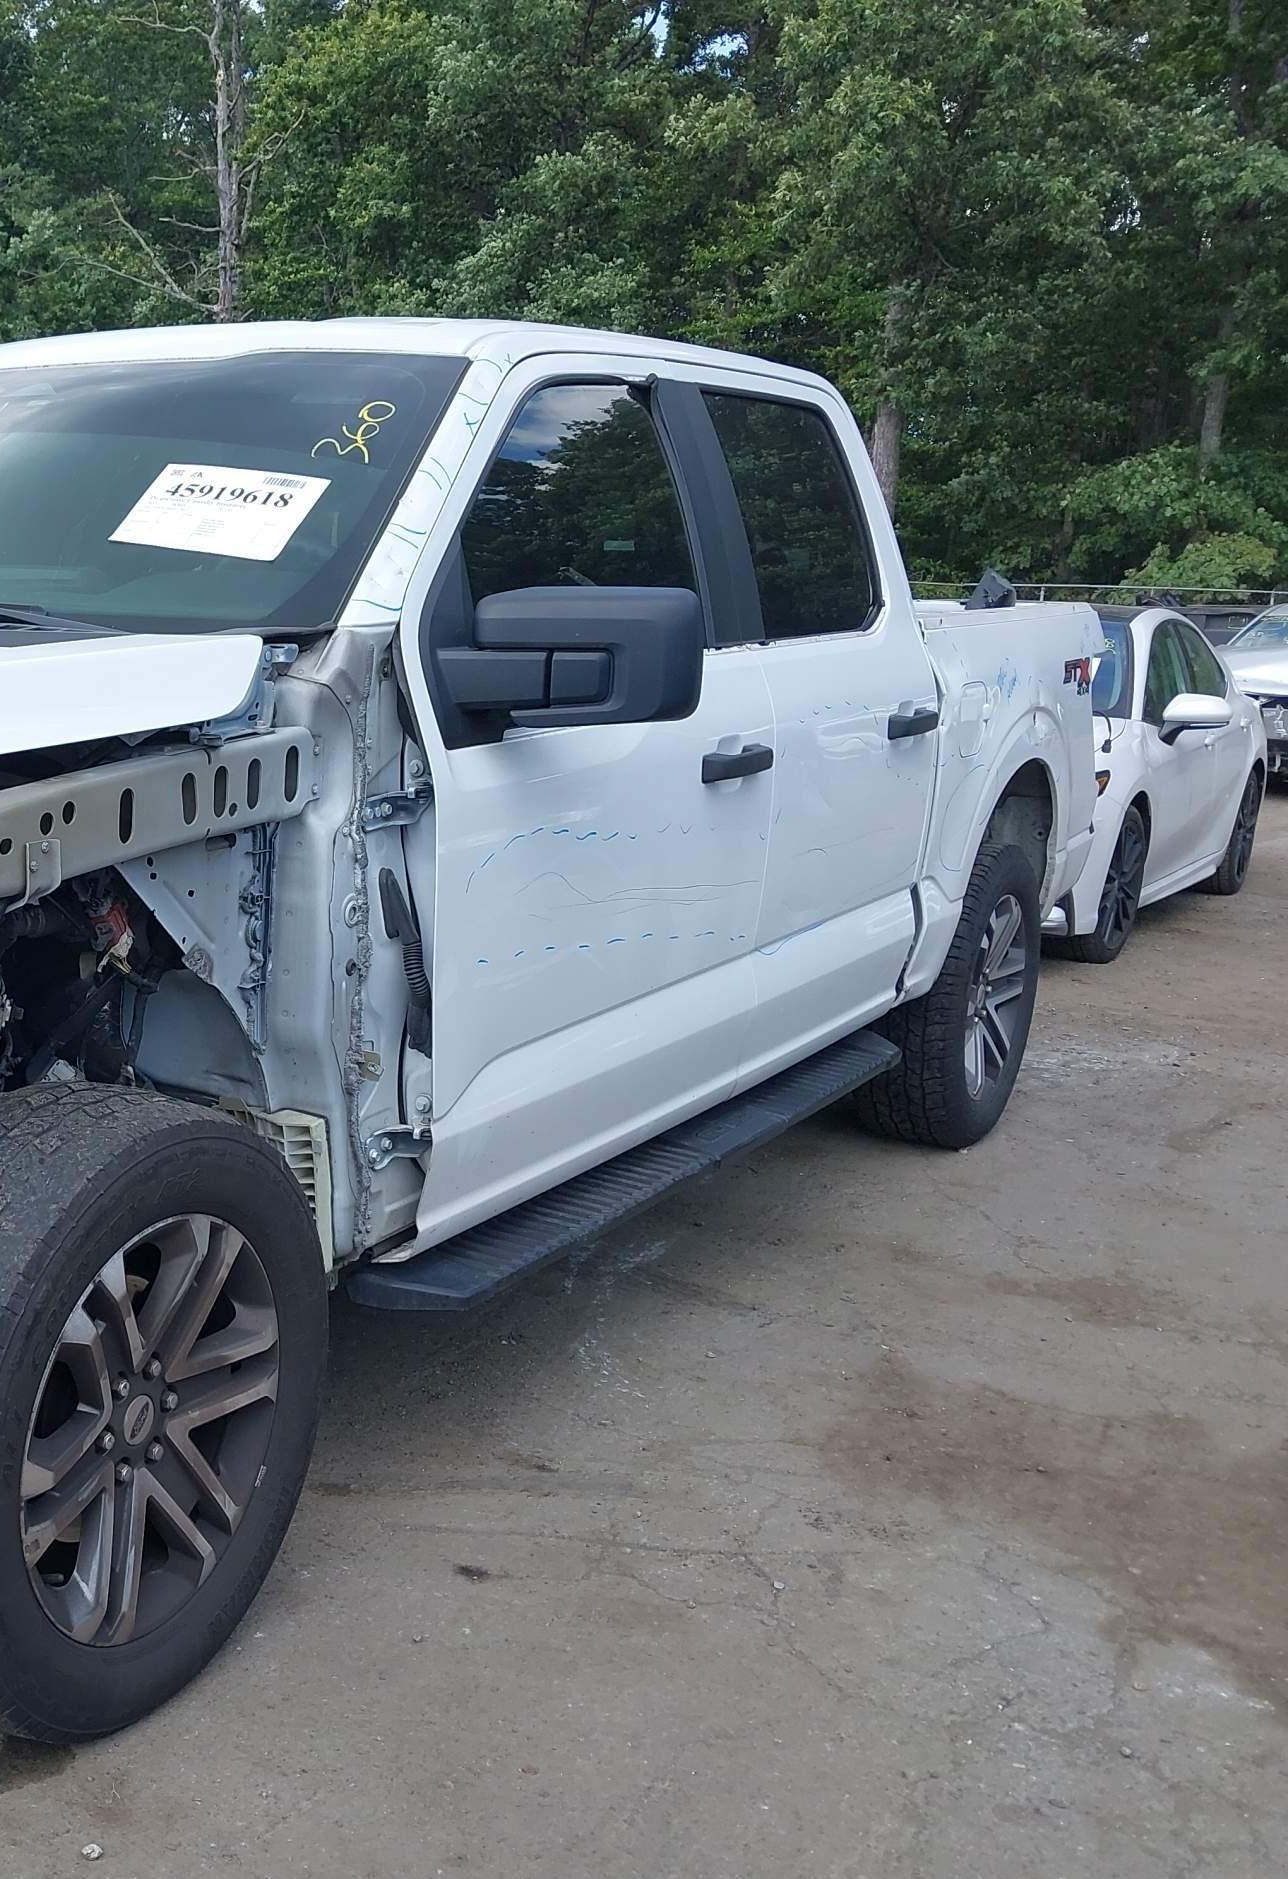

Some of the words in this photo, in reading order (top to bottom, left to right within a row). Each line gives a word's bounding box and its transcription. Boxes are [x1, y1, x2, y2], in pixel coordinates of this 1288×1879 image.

[311, 400, 396, 464] 360
[165, 482, 294, 508] 45919618
[1063, 656, 1091, 688] STX
